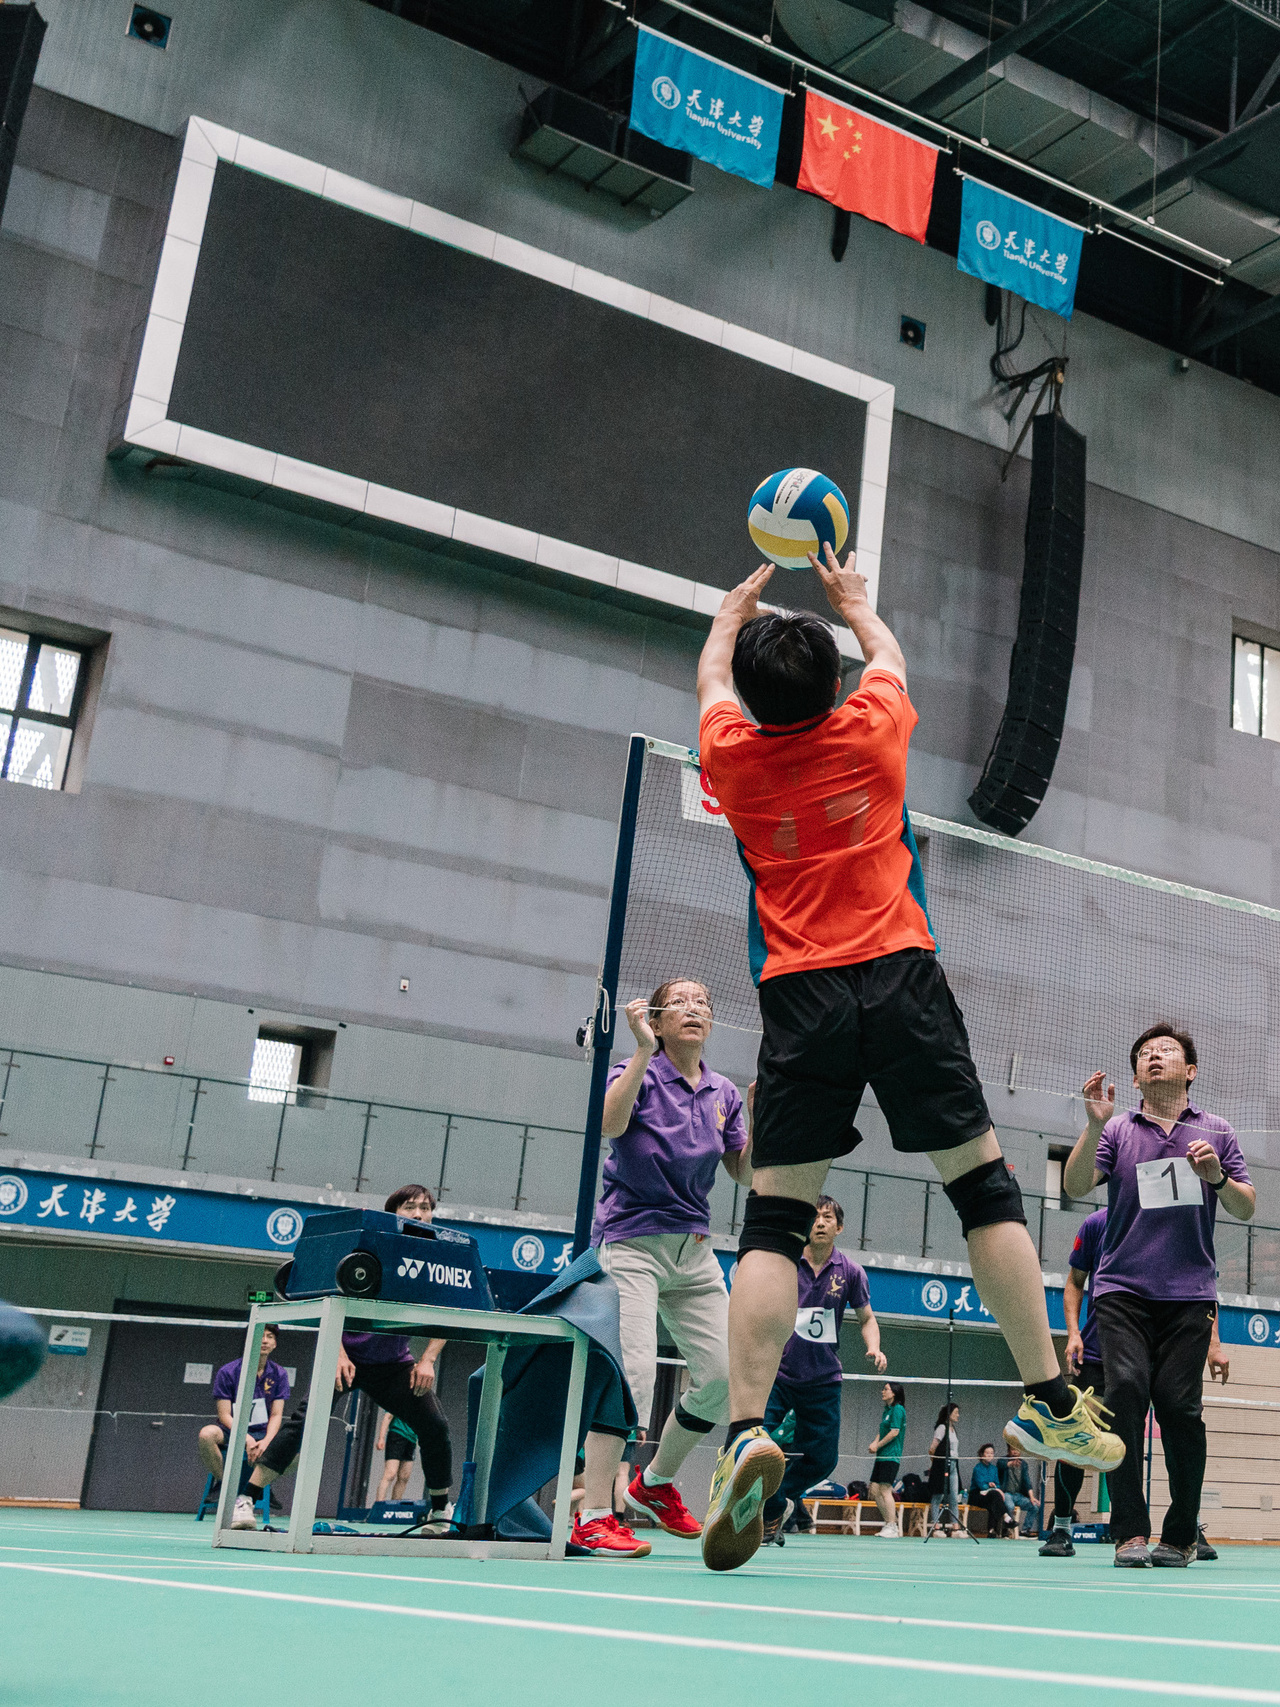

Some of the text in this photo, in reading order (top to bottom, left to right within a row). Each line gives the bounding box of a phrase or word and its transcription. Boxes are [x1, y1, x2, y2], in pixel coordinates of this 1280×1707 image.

[685, 106, 762, 150] Tianjin University
[687, 89, 764, 138] 天津大学
[1003, 248, 1068, 285] Tianjin University
[1004, 231, 1068, 274] 天津大学
[1161, 1162, 1179, 1201] 1
[37, 1184, 176, 1232] 天津大学
[427, 1262, 473, 1290] YONEX
[808, 1310, 824, 1339] 5
[394, 1511, 414, 1519] YONEX
